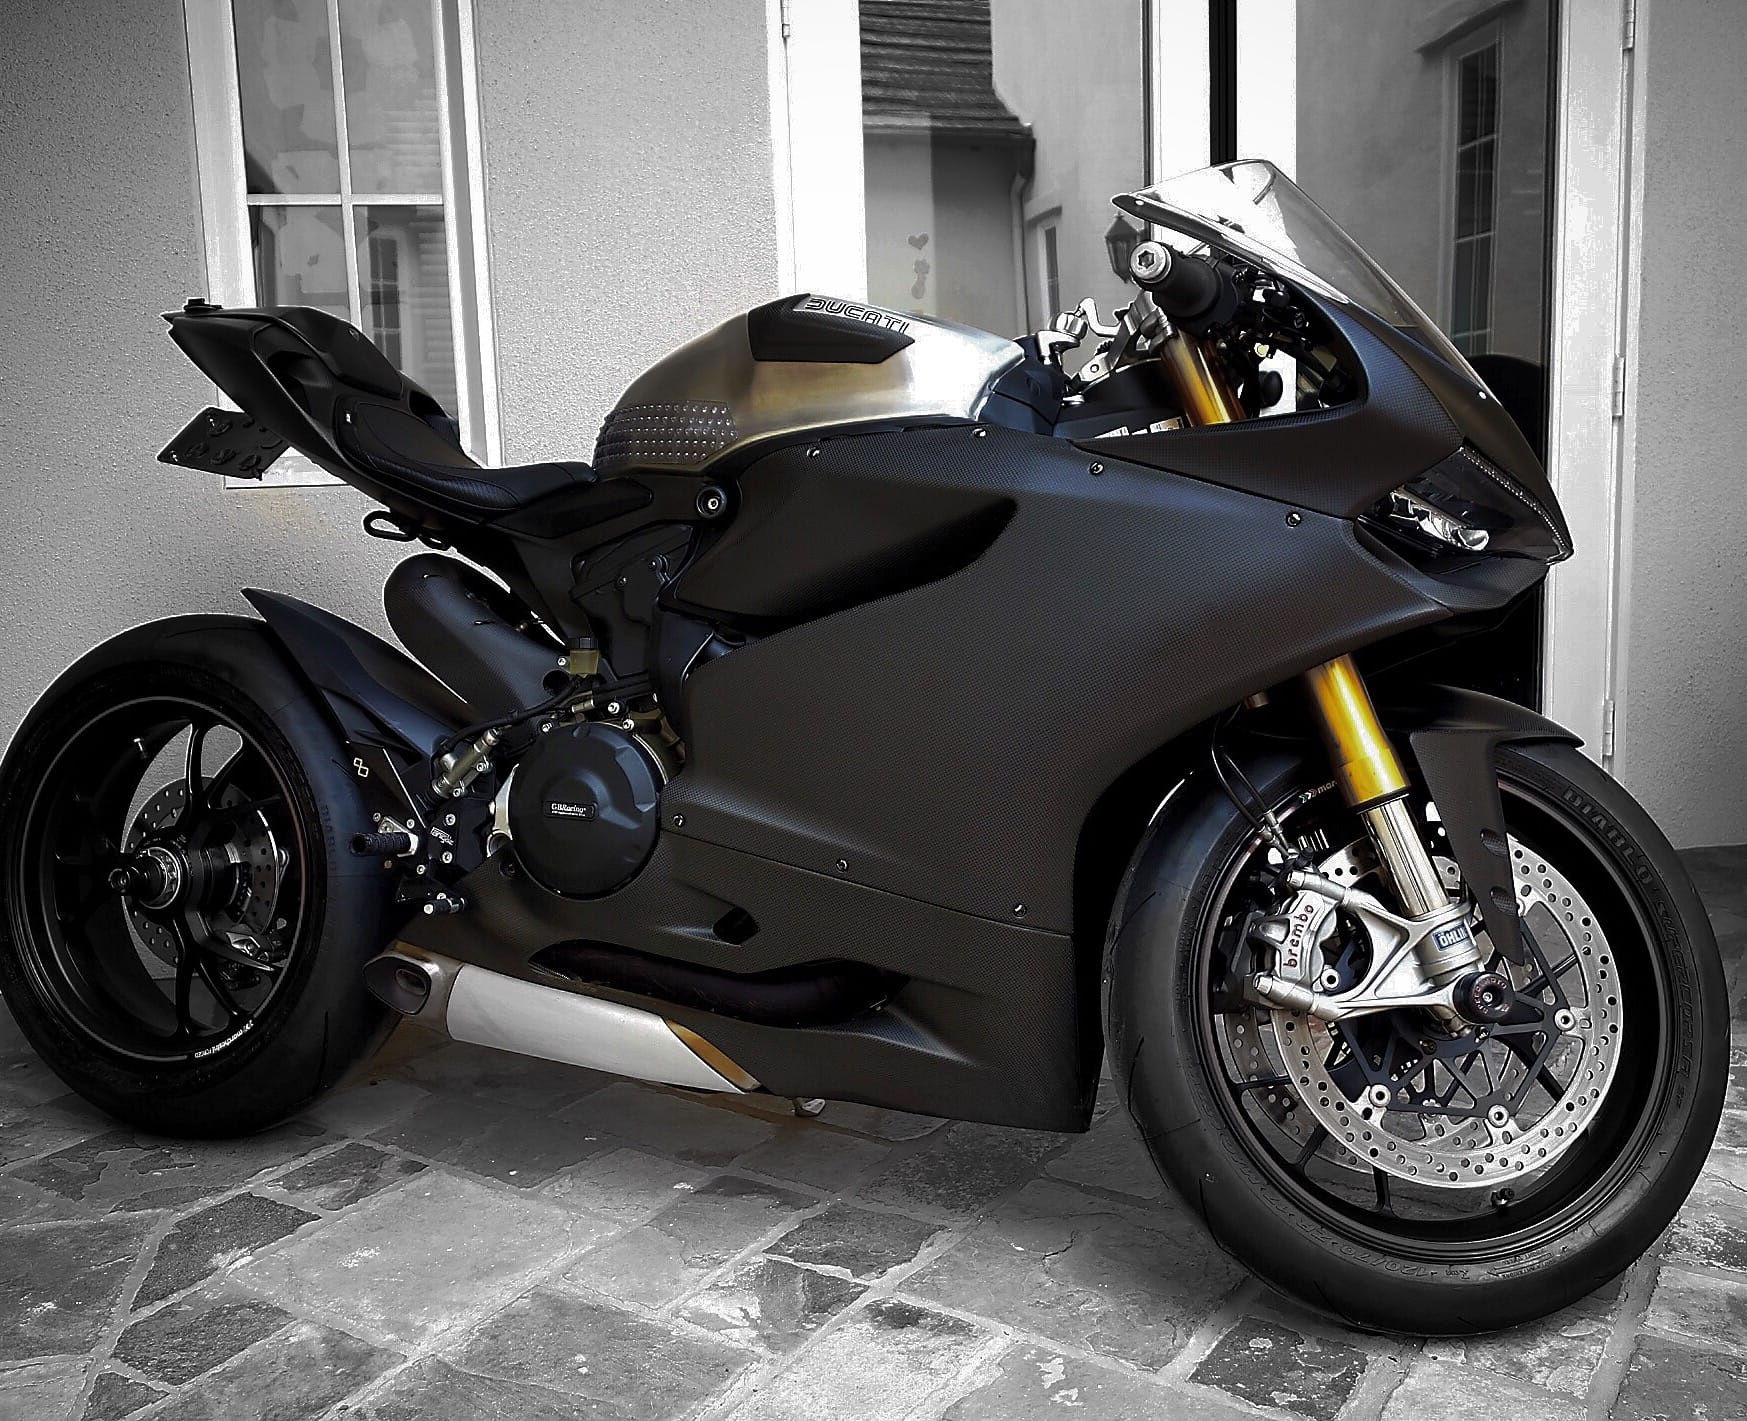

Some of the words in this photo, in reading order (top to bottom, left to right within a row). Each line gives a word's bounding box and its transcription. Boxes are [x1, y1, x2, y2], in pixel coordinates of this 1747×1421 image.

[804, 297, 910, 334] DUCATI
[1563, 788, 1654, 885] DIABLO
[1283, 904, 1314, 969] brembo
[1338, 1244, 1428, 1279] 120/70
